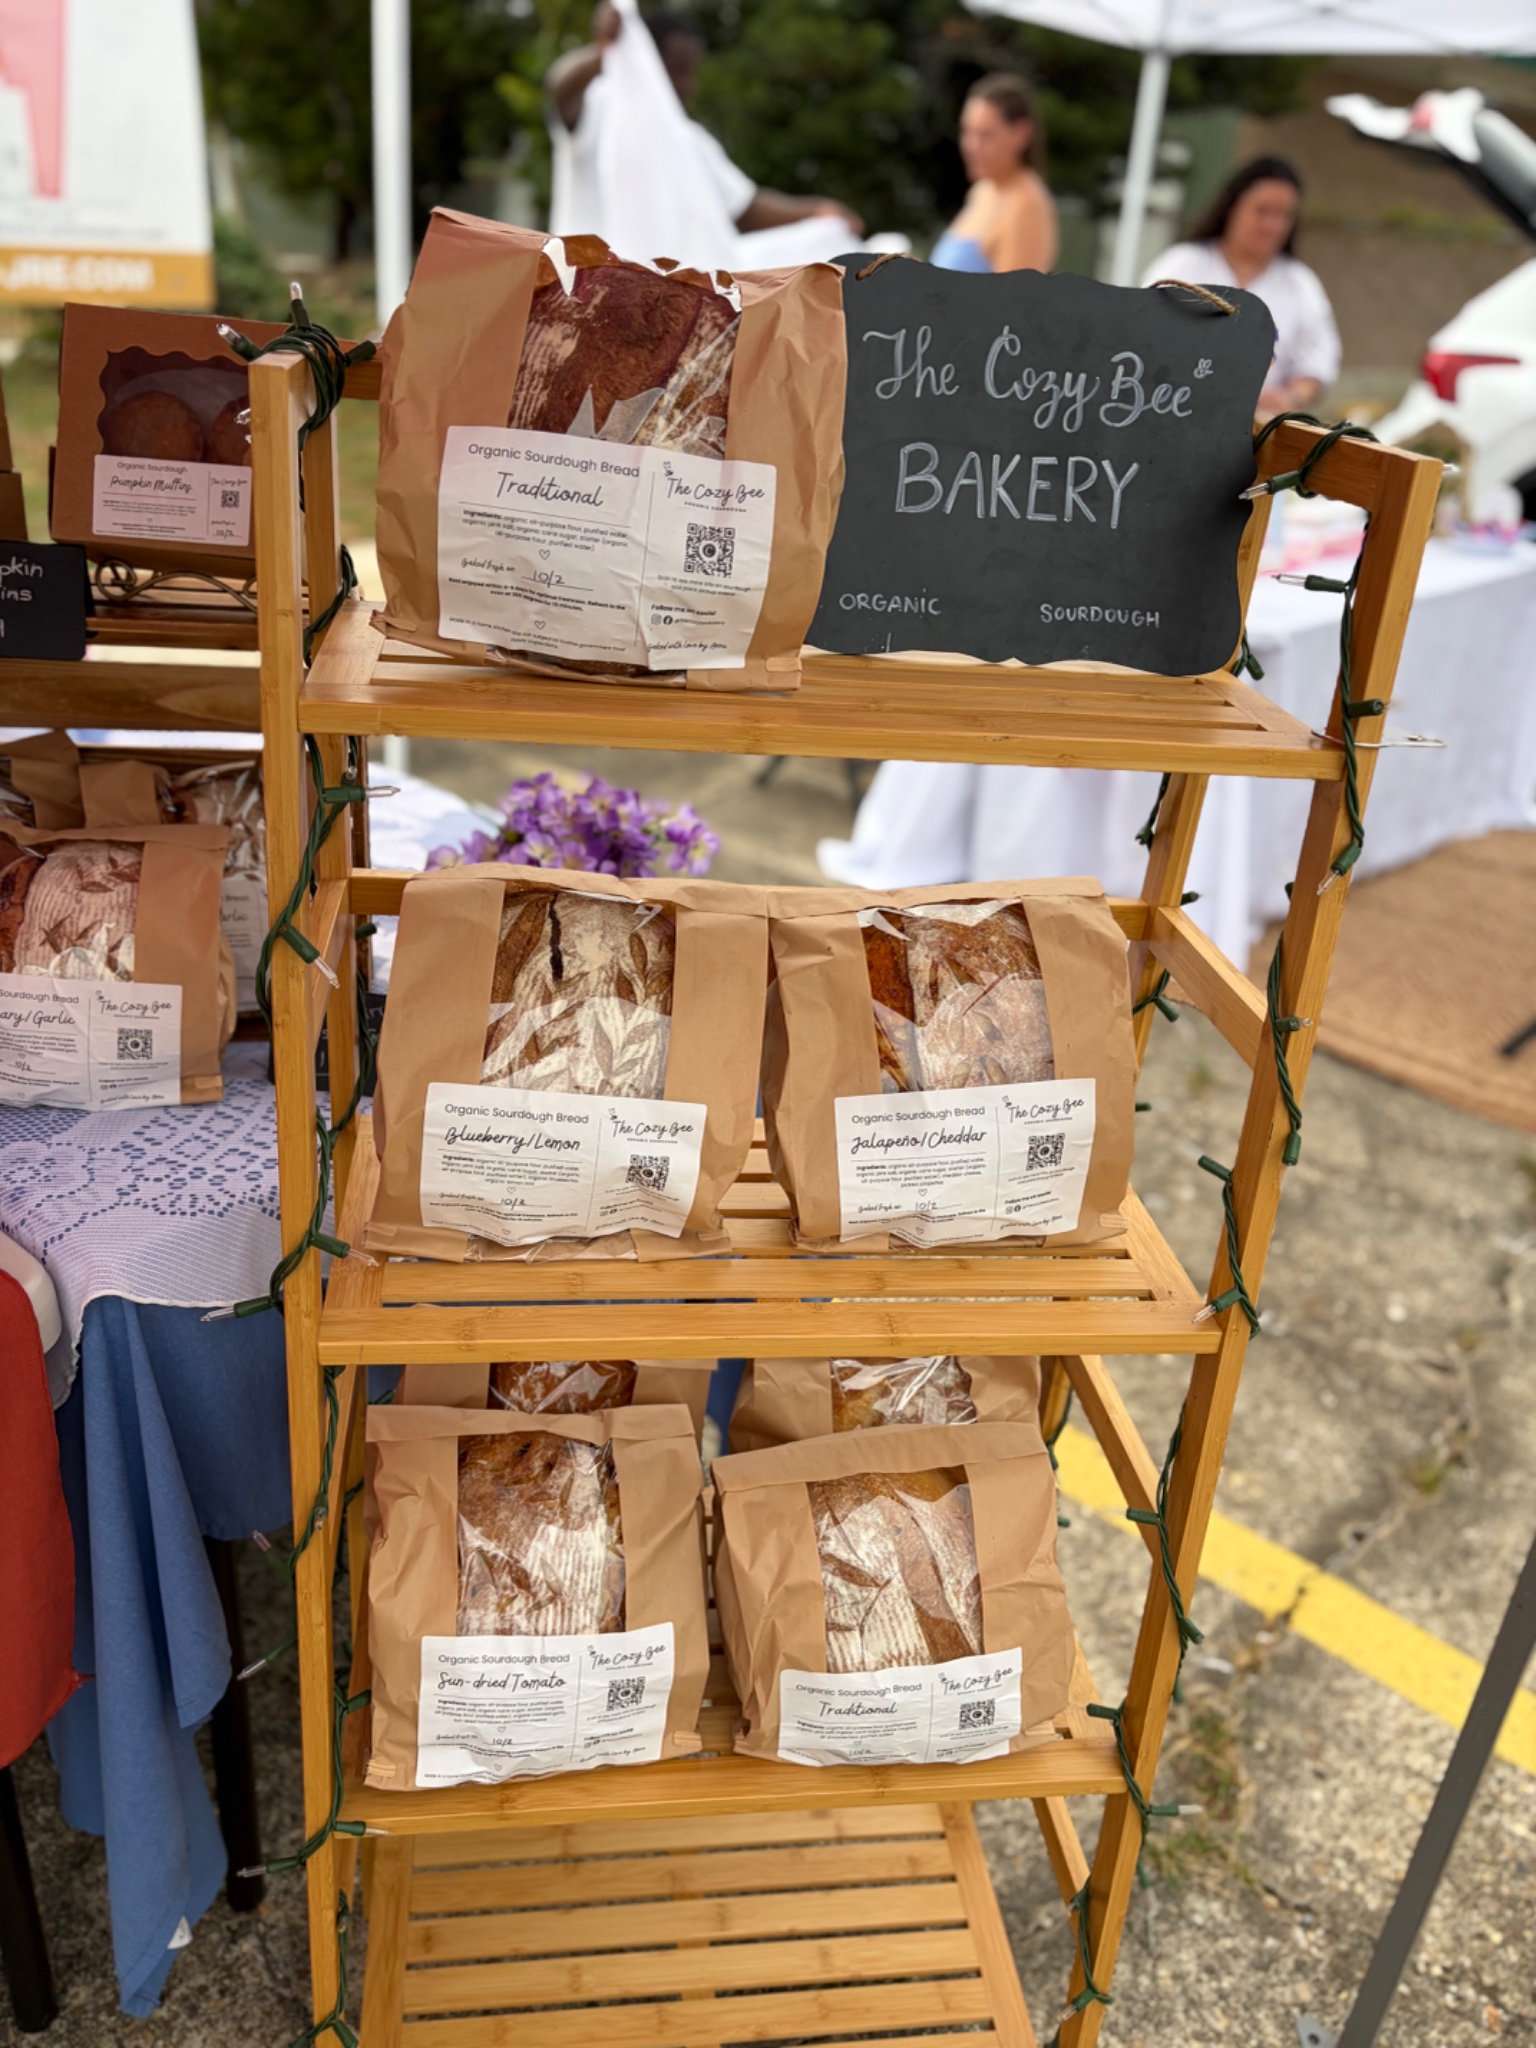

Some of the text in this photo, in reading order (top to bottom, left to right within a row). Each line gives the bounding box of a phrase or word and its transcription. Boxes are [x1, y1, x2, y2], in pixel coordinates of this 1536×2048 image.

[862, 325, 1192, 433] The Cozy Bee
[117, 461, 188, 475] Organic Sourdough
[468, 444, 640, 477] Organic Sourdough Bread
[110, 475, 193, 494] Pumpkin Muffins
[496, 471, 604, 507] Traditional
[667, 477, 765, 506] The Cozy Bee
[895, 442, 1140, 529] BAKERY
[533, 569, 565, 588] 10/2
[839, 588, 1160, 628] ORGANIC SOURDOUGH
[52, 995, 79, 1004] Bread
[100, 1000, 172, 1015] The Cozy Bee
[444, 1103, 589, 1124] Organic Sourdough Bread
[851, 1106, 986, 1126] Organic Sourdough Bread
[1008, 1106, 1028, 1124] The
[1029, 1101, 1061, 1119] Cozy
[1062, 1098, 1085, 1115] Bee
[444, 1125, 581, 1154] Blueberry/Lemon
[612, 1120, 695, 1140] The Cozy Bee
[850, 1125, 987, 1155] Jalapeño/Cheddar
[499, 1197, 527, 1211] 10/2
[916, 1201, 938, 1212] 10/2
[438, 1653, 570, 1666] Organic Sourdough Bread
[591, 1652, 611, 1670] The
[613, 1650, 644, 1666] Cozy
[645, 1644, 666, 1661] Bee
[437, 1671, 567, 1692] Sun-dried Tomato
[795, 1683, 922, 1698] Organic Sourdough Bread
[943, 1679, 962, 1696] The
[963, 1675, 992, 1689] Cozy
[993, 1667, 1014, 1682] Bee
[819, 1700, 898, 1718] Traditional
[493, 1738, 513, 1748] 10/2
